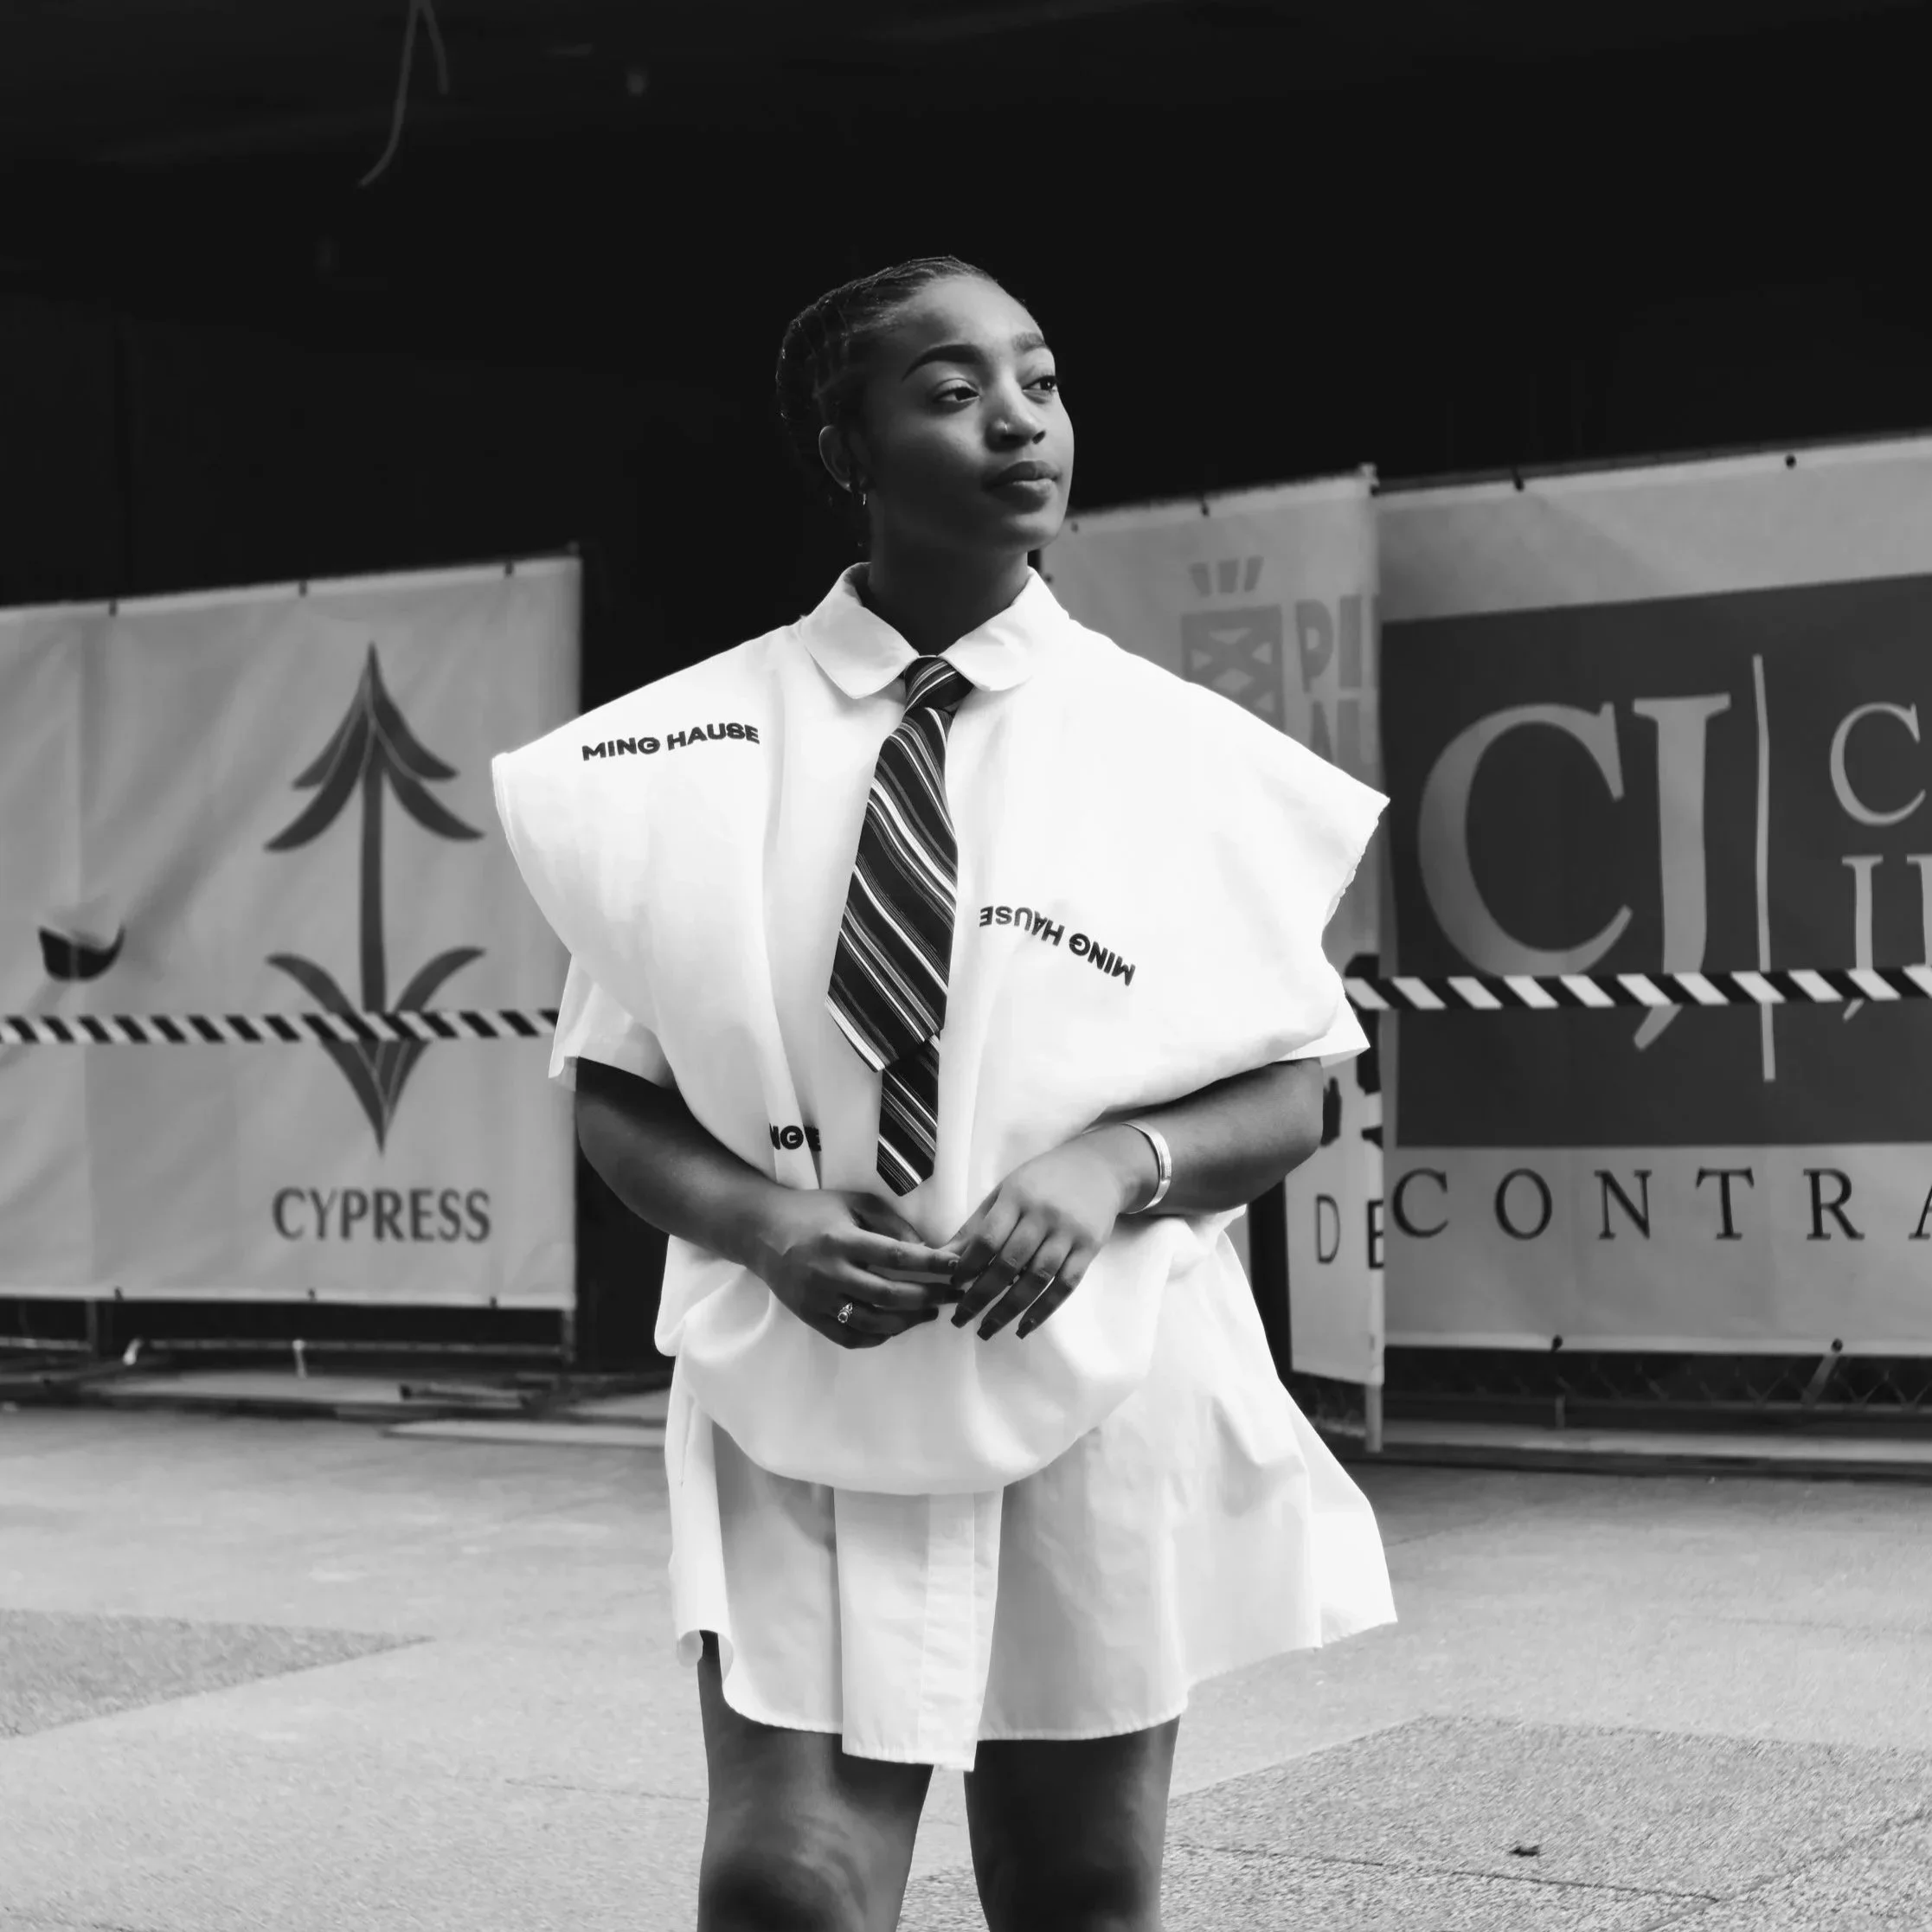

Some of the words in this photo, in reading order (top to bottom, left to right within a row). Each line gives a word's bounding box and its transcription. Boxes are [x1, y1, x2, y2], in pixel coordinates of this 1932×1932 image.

[581, 737, 661, 761] MING
[666, 722, 761, 751] HAUSE
[979, 905, 1065, 947] HAUSE
[1069, 933, 1136, 986] MING
[272, 1186, 491, 1243] CYPRESS
